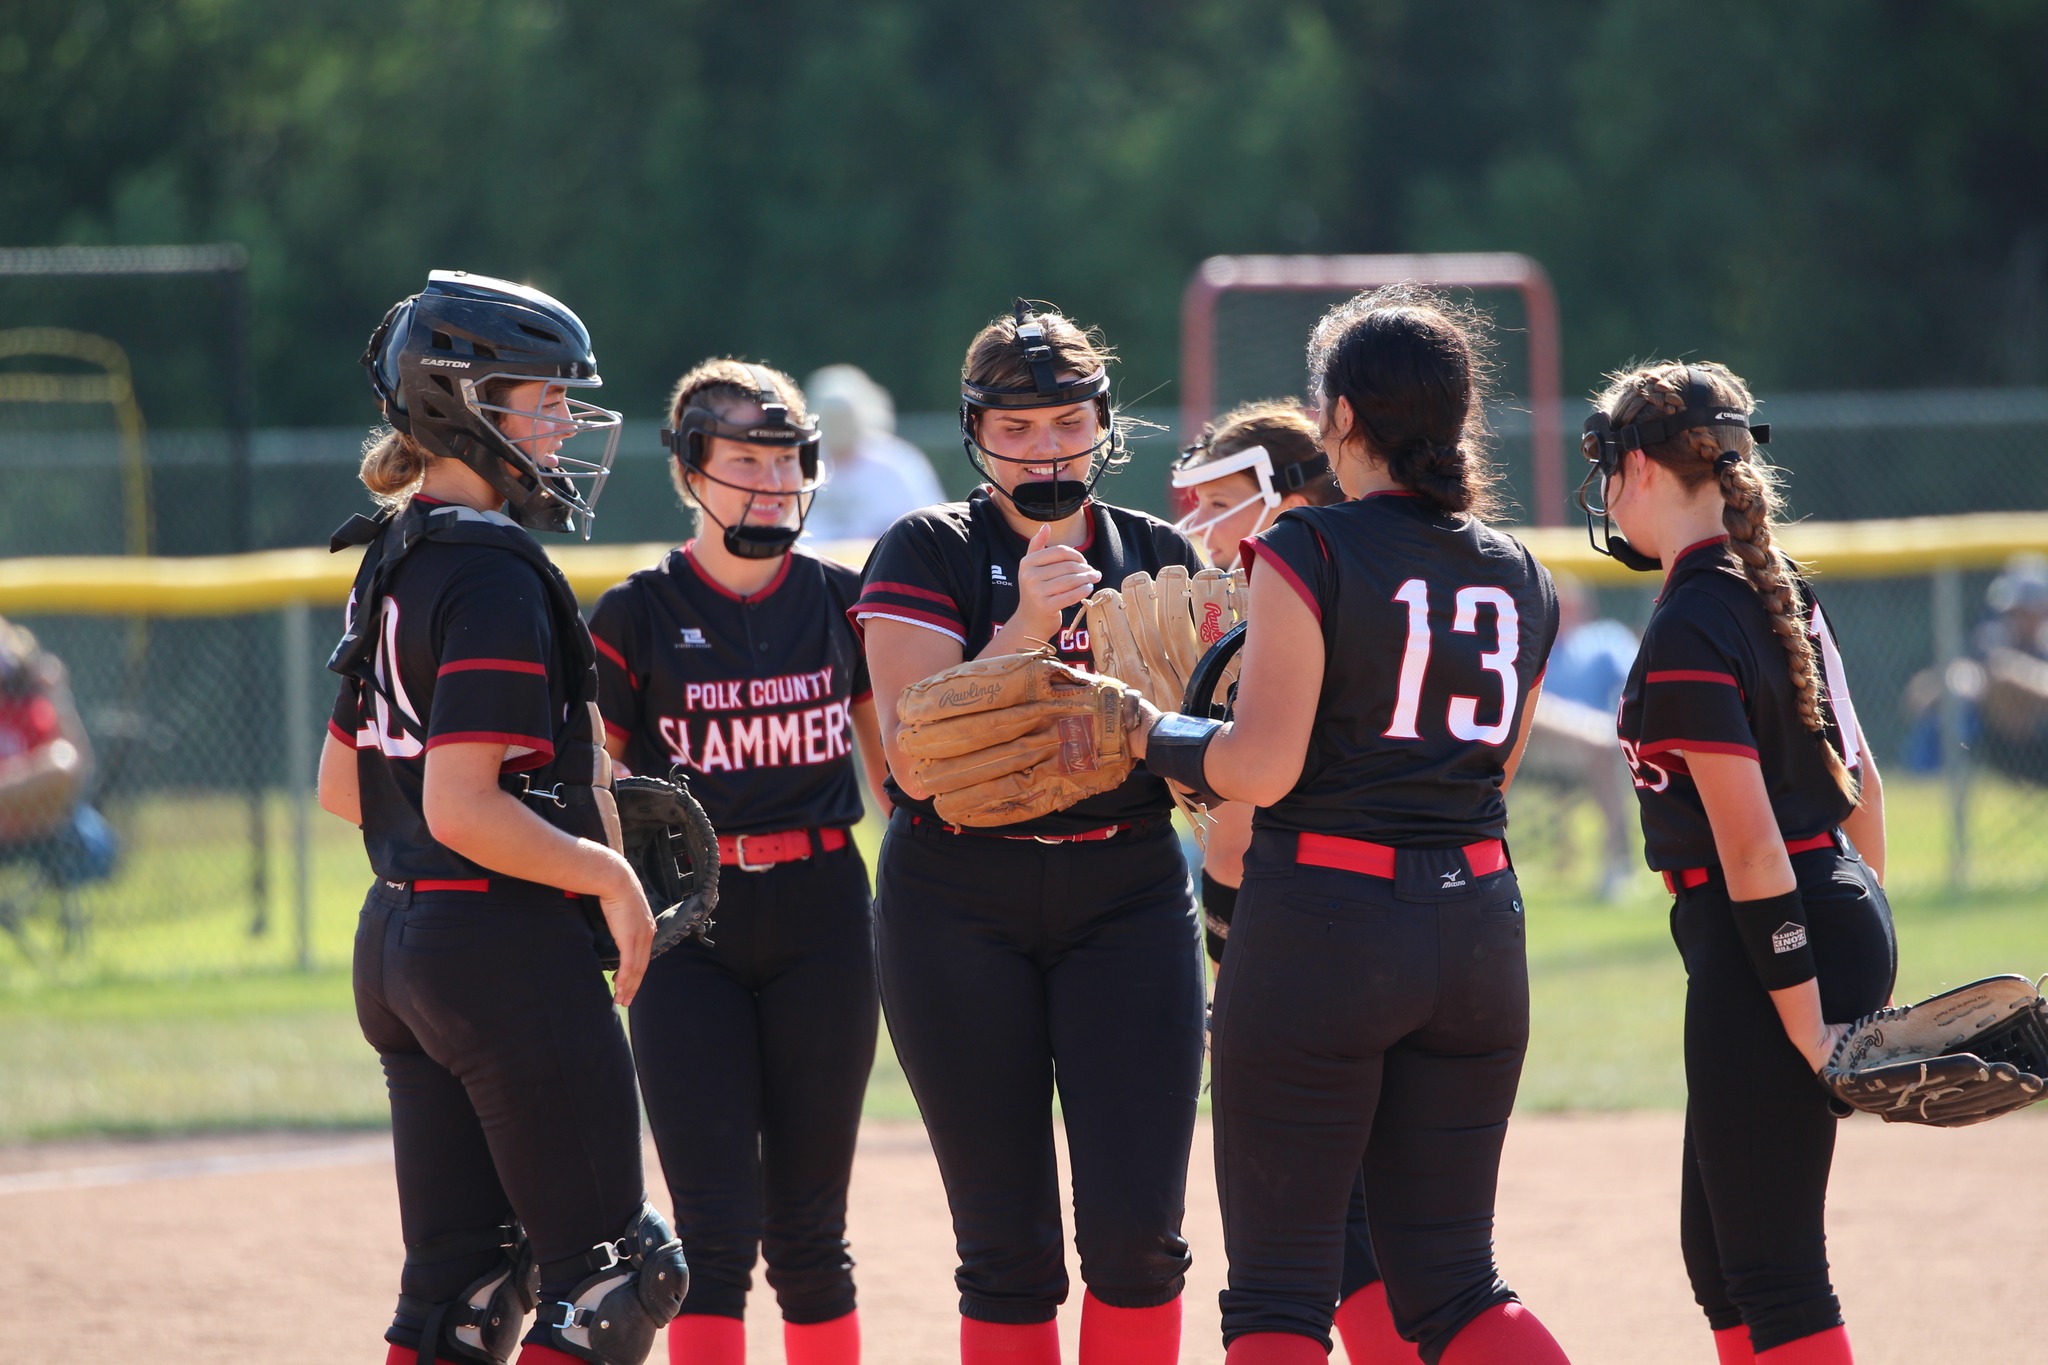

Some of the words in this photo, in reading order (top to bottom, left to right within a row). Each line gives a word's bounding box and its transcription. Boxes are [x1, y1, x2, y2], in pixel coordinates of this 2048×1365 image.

[420, 358, 471, 369] EASTON
[1379, 577, 1520, 748] 13
[685, 680, 745, 711] POLK
[747, 664, 833, 707] COUNTY
[938, 681, 1003, 709] Rawlings
[1773, 928, 1803, 940] SPORTS
[1774, 933, 1805, 948] ZONE
